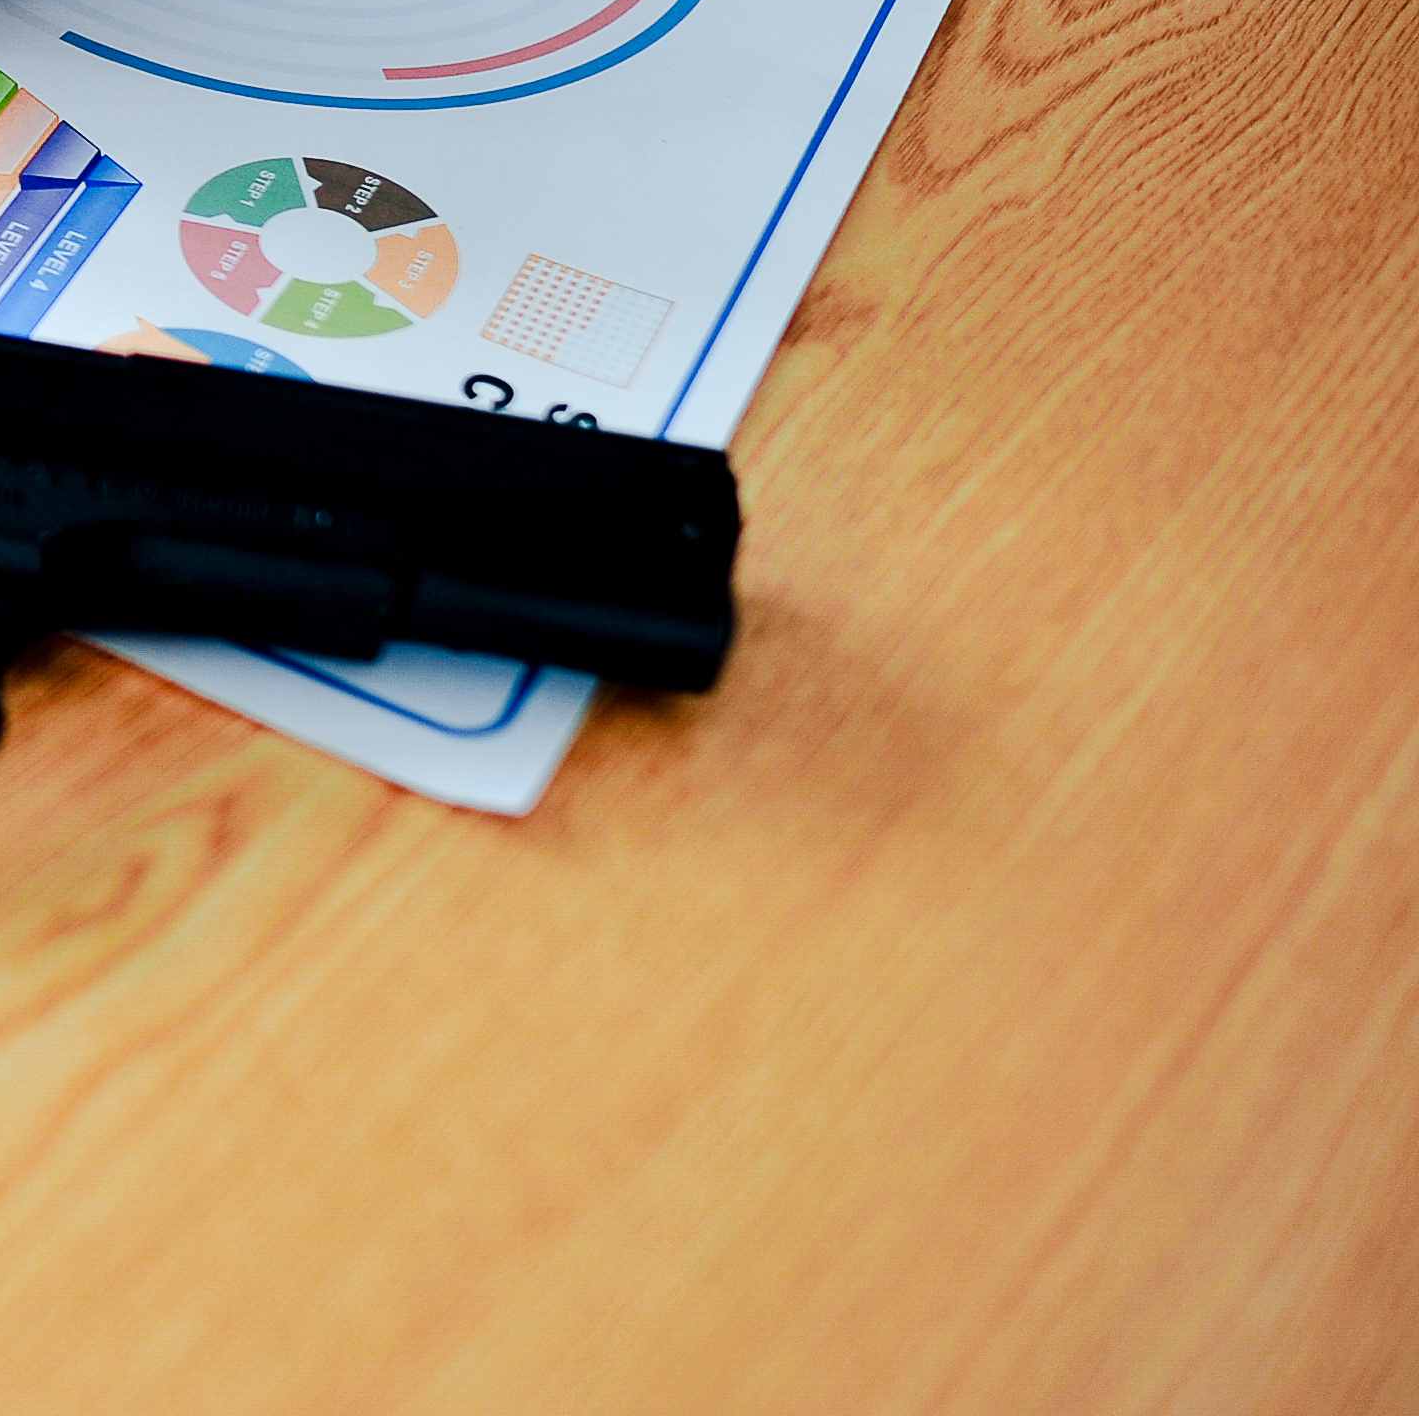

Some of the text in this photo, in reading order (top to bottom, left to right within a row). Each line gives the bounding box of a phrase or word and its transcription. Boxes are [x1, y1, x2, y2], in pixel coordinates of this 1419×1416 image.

[240, 170, 276, 208] STEP 1
[345, 176, 382, 215] STEP 2
[29, 230, 88, 292] LEVEL 4
